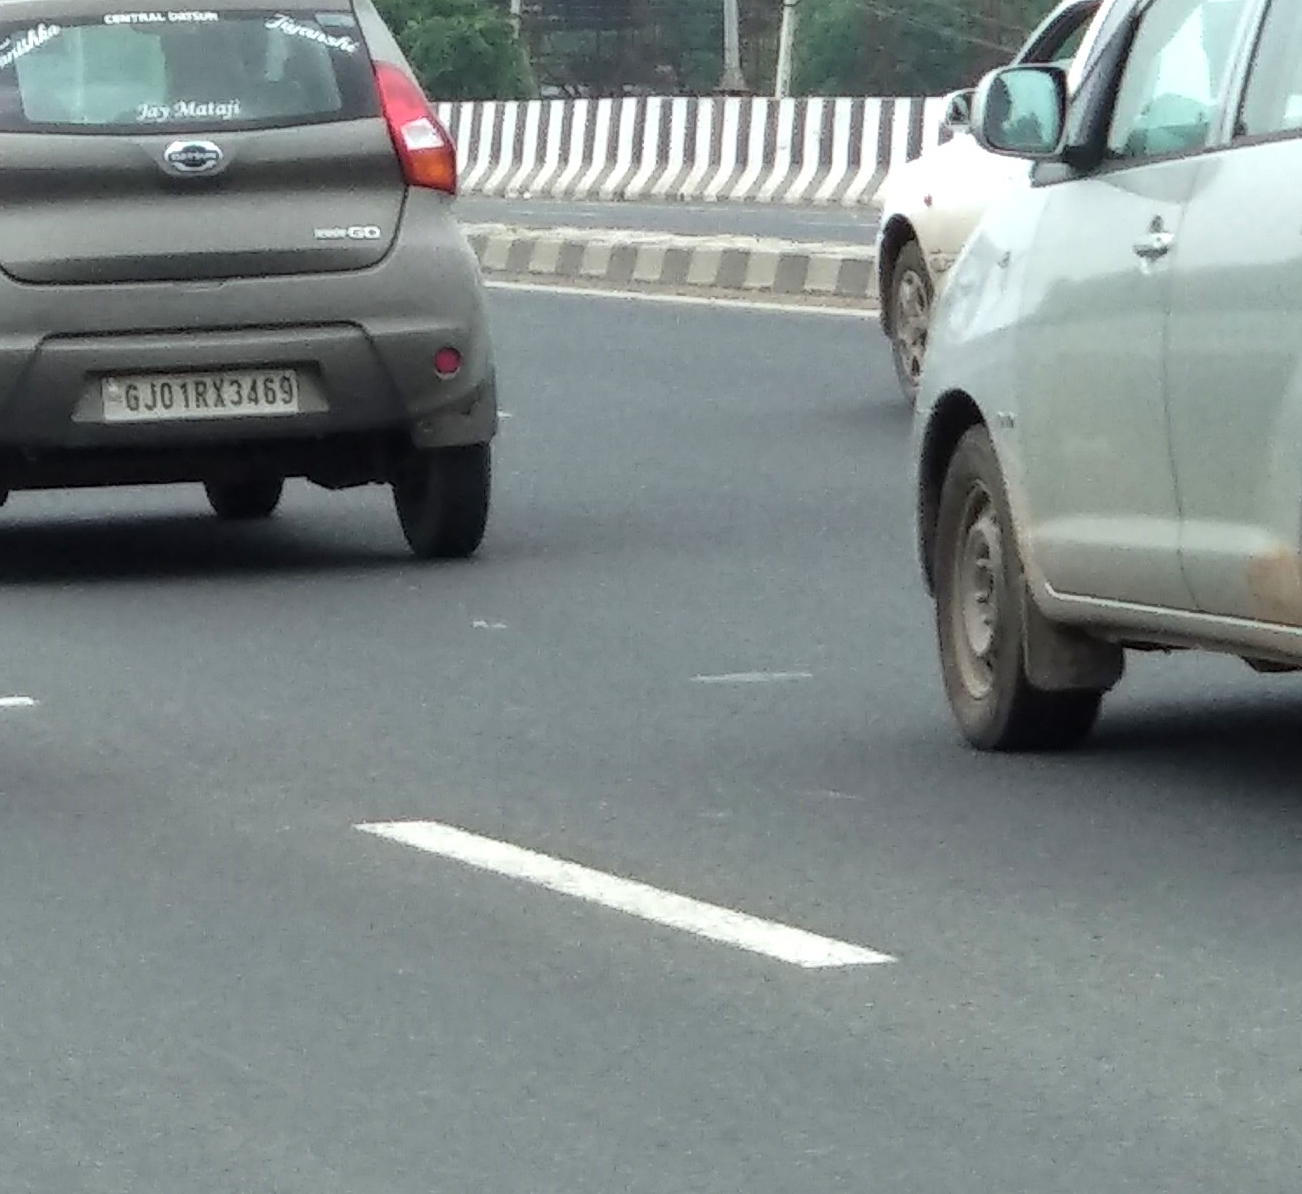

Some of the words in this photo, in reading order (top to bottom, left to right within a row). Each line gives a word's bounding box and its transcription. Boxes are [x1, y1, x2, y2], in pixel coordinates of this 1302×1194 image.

[103, 13, 167, 24] CENTRAL
[167, 11, 219, 22] DATSUN
[137, 103, 170, 123] Jay
[173, 99, 241, 121] Mataji
[125, 375, 293, 411] GJ01RX3469
